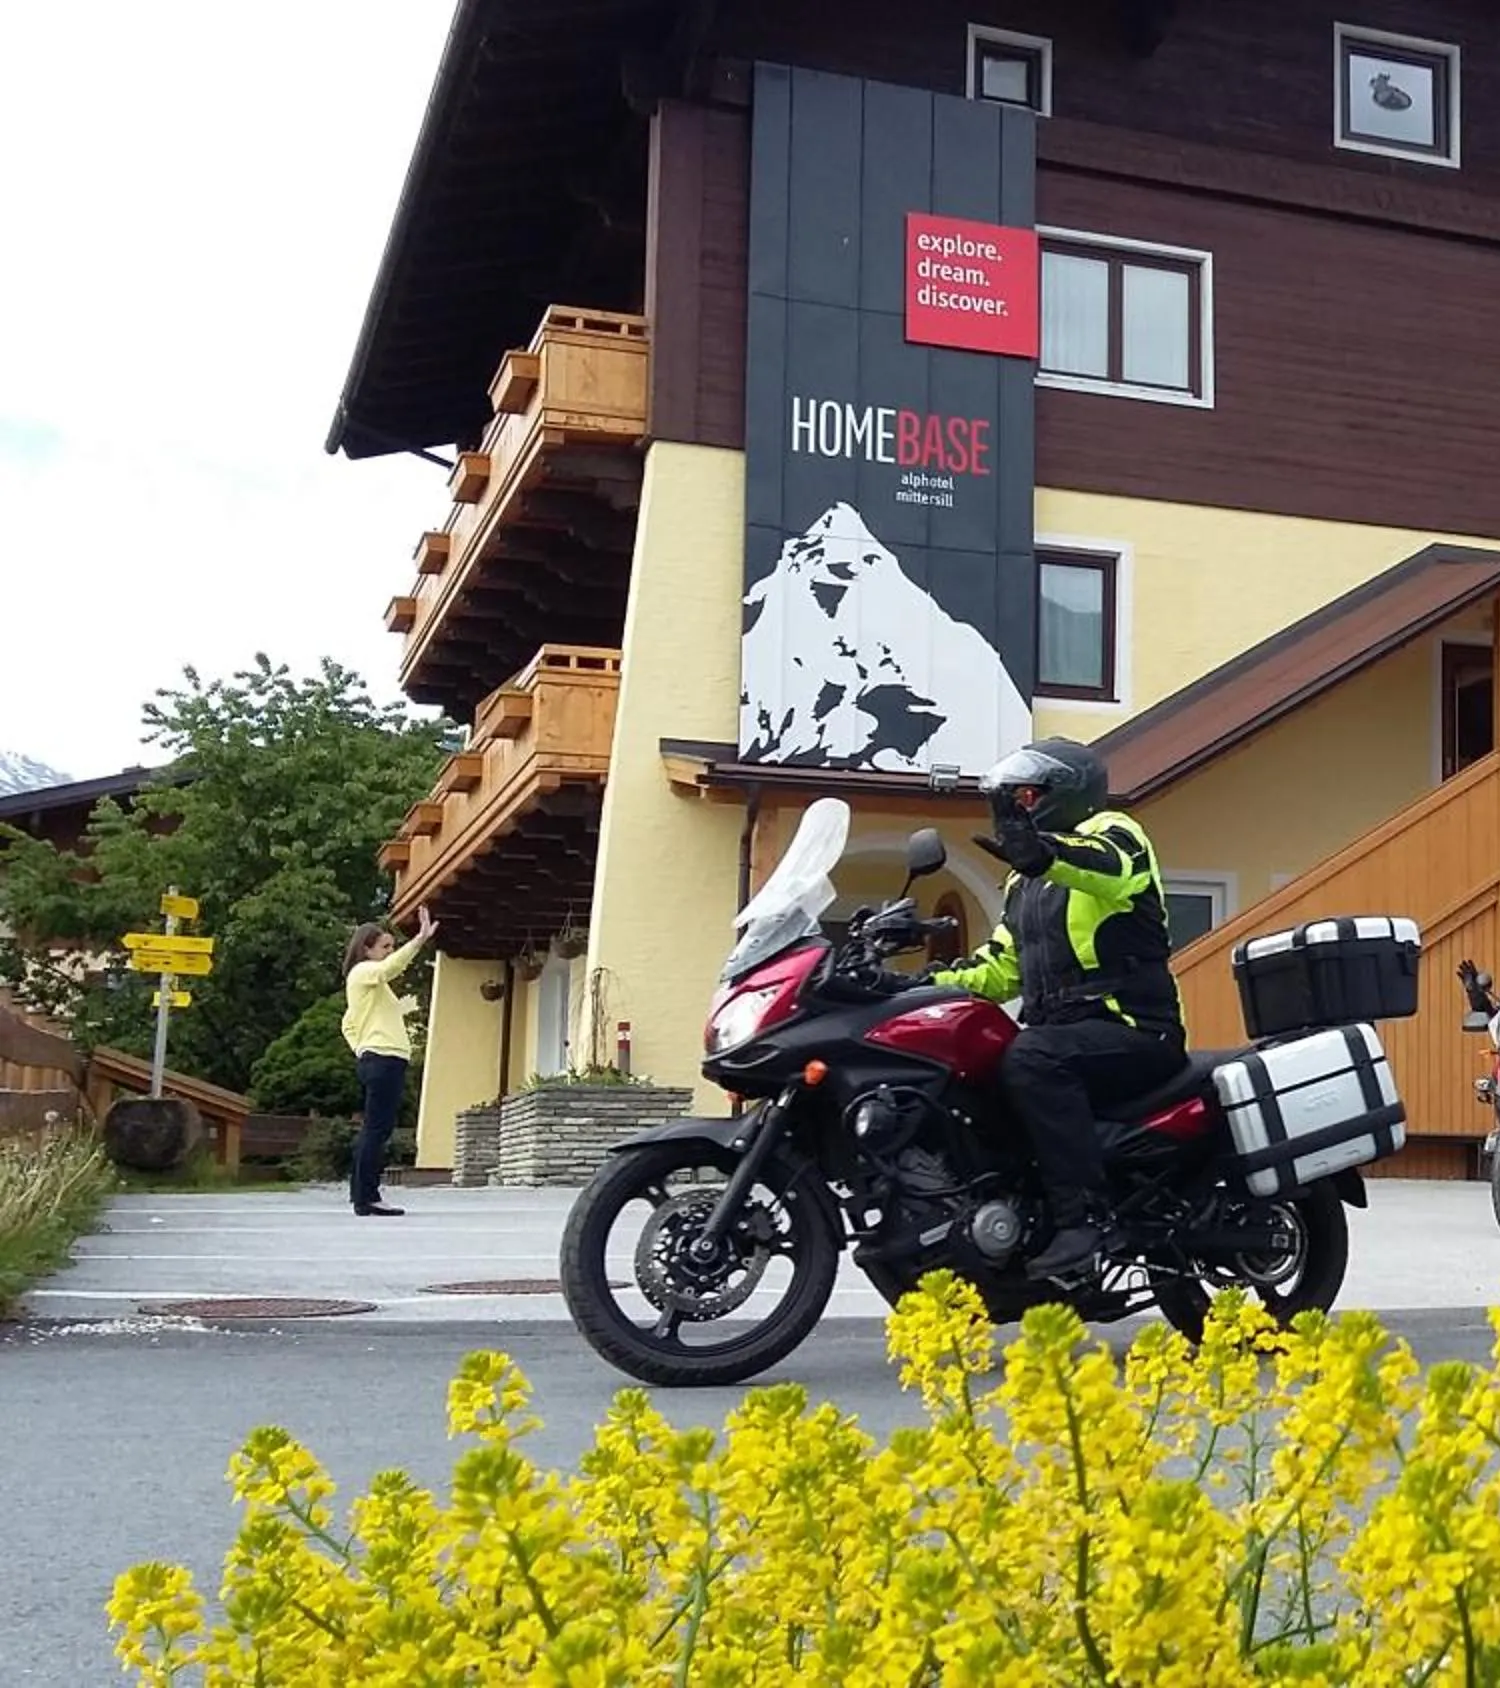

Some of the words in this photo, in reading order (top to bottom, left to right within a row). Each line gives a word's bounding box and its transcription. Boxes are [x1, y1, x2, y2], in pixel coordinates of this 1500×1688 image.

[917, 234, 1002, 262] explore.
[917, 256, 990, 286] dream.
[917, 284, 1008, 316] discover.
[792, 397, 990, 475] HOMEBASE
[901, 472, 954, 490] alphotel
[896, 490, 953, 507] mittersill
